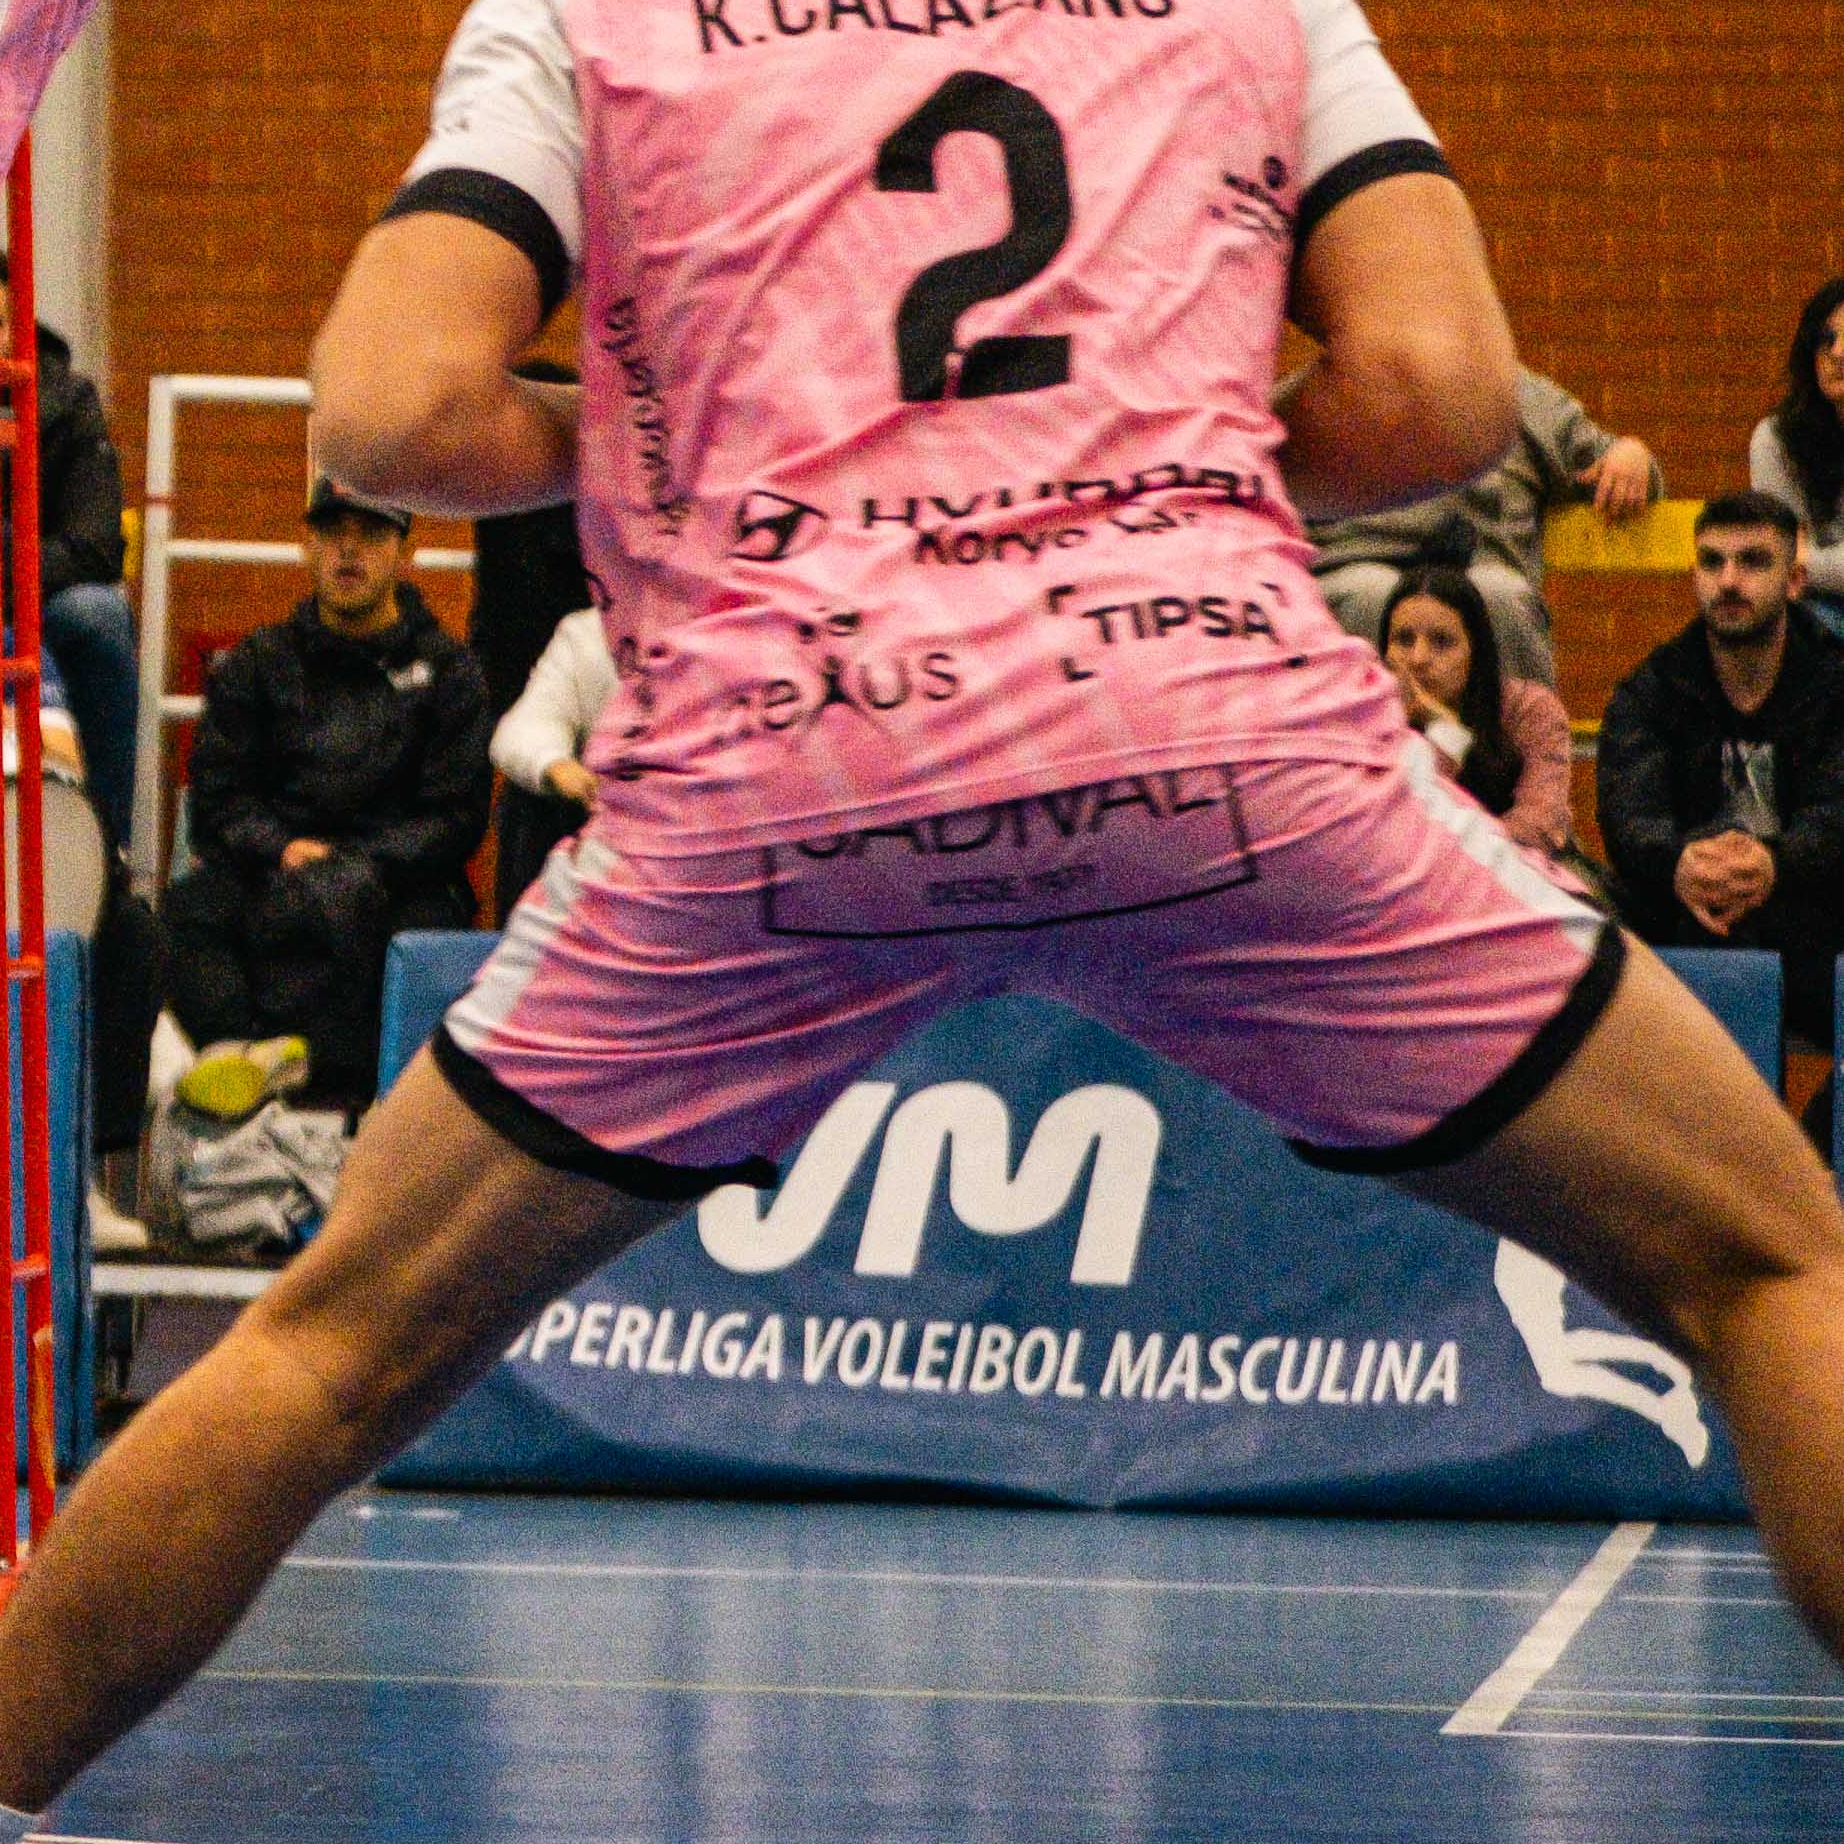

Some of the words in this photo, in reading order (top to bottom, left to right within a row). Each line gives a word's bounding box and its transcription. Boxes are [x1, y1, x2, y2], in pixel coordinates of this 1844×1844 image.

[873, 70, 1073, 403] 2
[1081, 595, 1281, 646] TIPSA
[801, 1315, 1089, 1399] VOLEIBOL
[1101, 1329, 1460, 1406] MASCULINA
